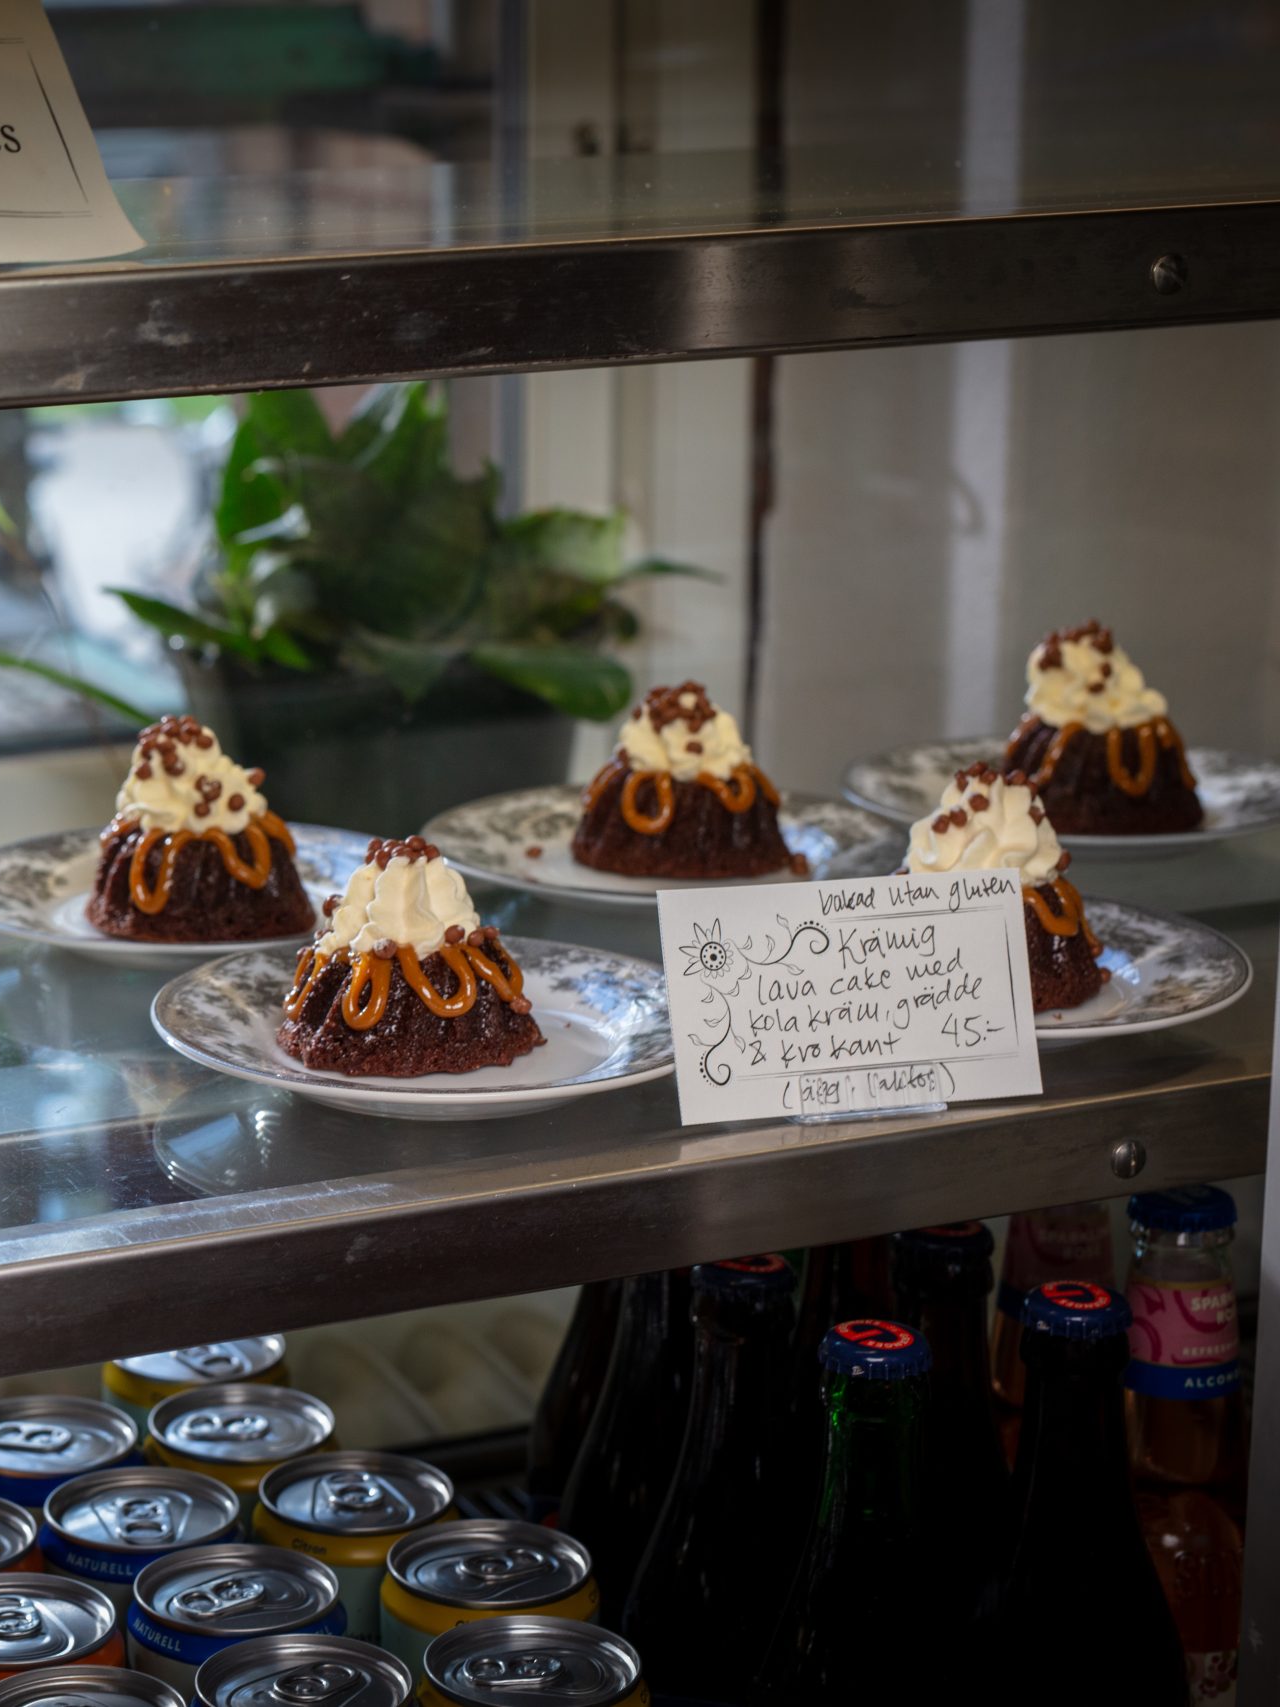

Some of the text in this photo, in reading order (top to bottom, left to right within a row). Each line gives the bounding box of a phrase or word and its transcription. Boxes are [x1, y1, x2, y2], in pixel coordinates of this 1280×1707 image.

[889, 881, 938, 906] utan
[949, 877, 1016, 912] gluten
[838, 925, 936, 969] Krämig
[758, 948, 964, 1005] lava cake med
[897, 977, 983, 1029] grädde
[65, 1551, 135, 1578] NATURELL
[132, 1617, 182, 1653] NATURELL
